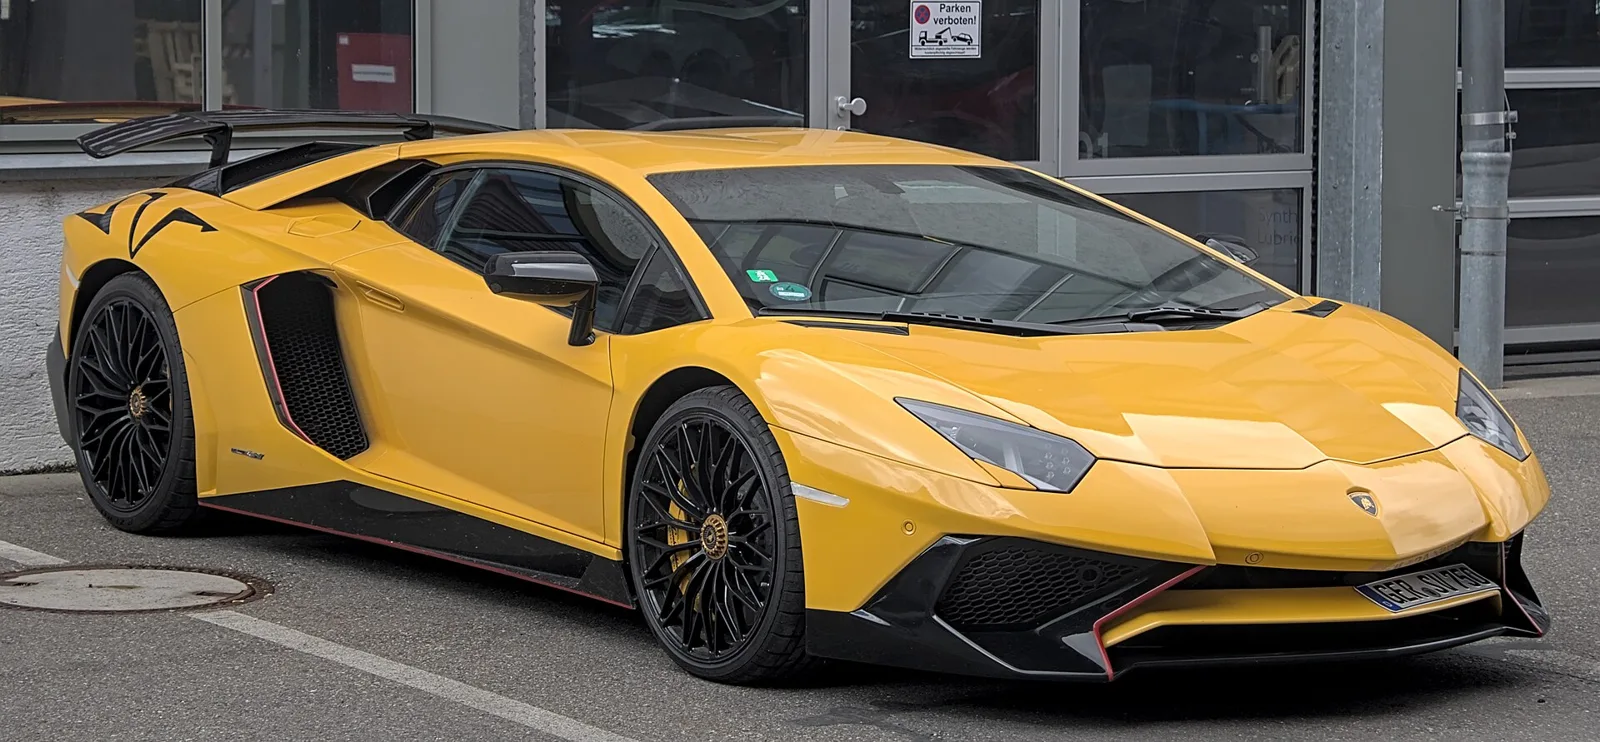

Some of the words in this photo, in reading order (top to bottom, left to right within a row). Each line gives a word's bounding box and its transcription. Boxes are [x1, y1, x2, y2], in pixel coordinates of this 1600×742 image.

[939, 4, 971, 13] Parken
[933, 16, 977, 25] verboten!
[1372, 579, 1429, 604] GER
[1417, 572, 1459, 594] SV
[1443, 567, 1491, 590] 750
